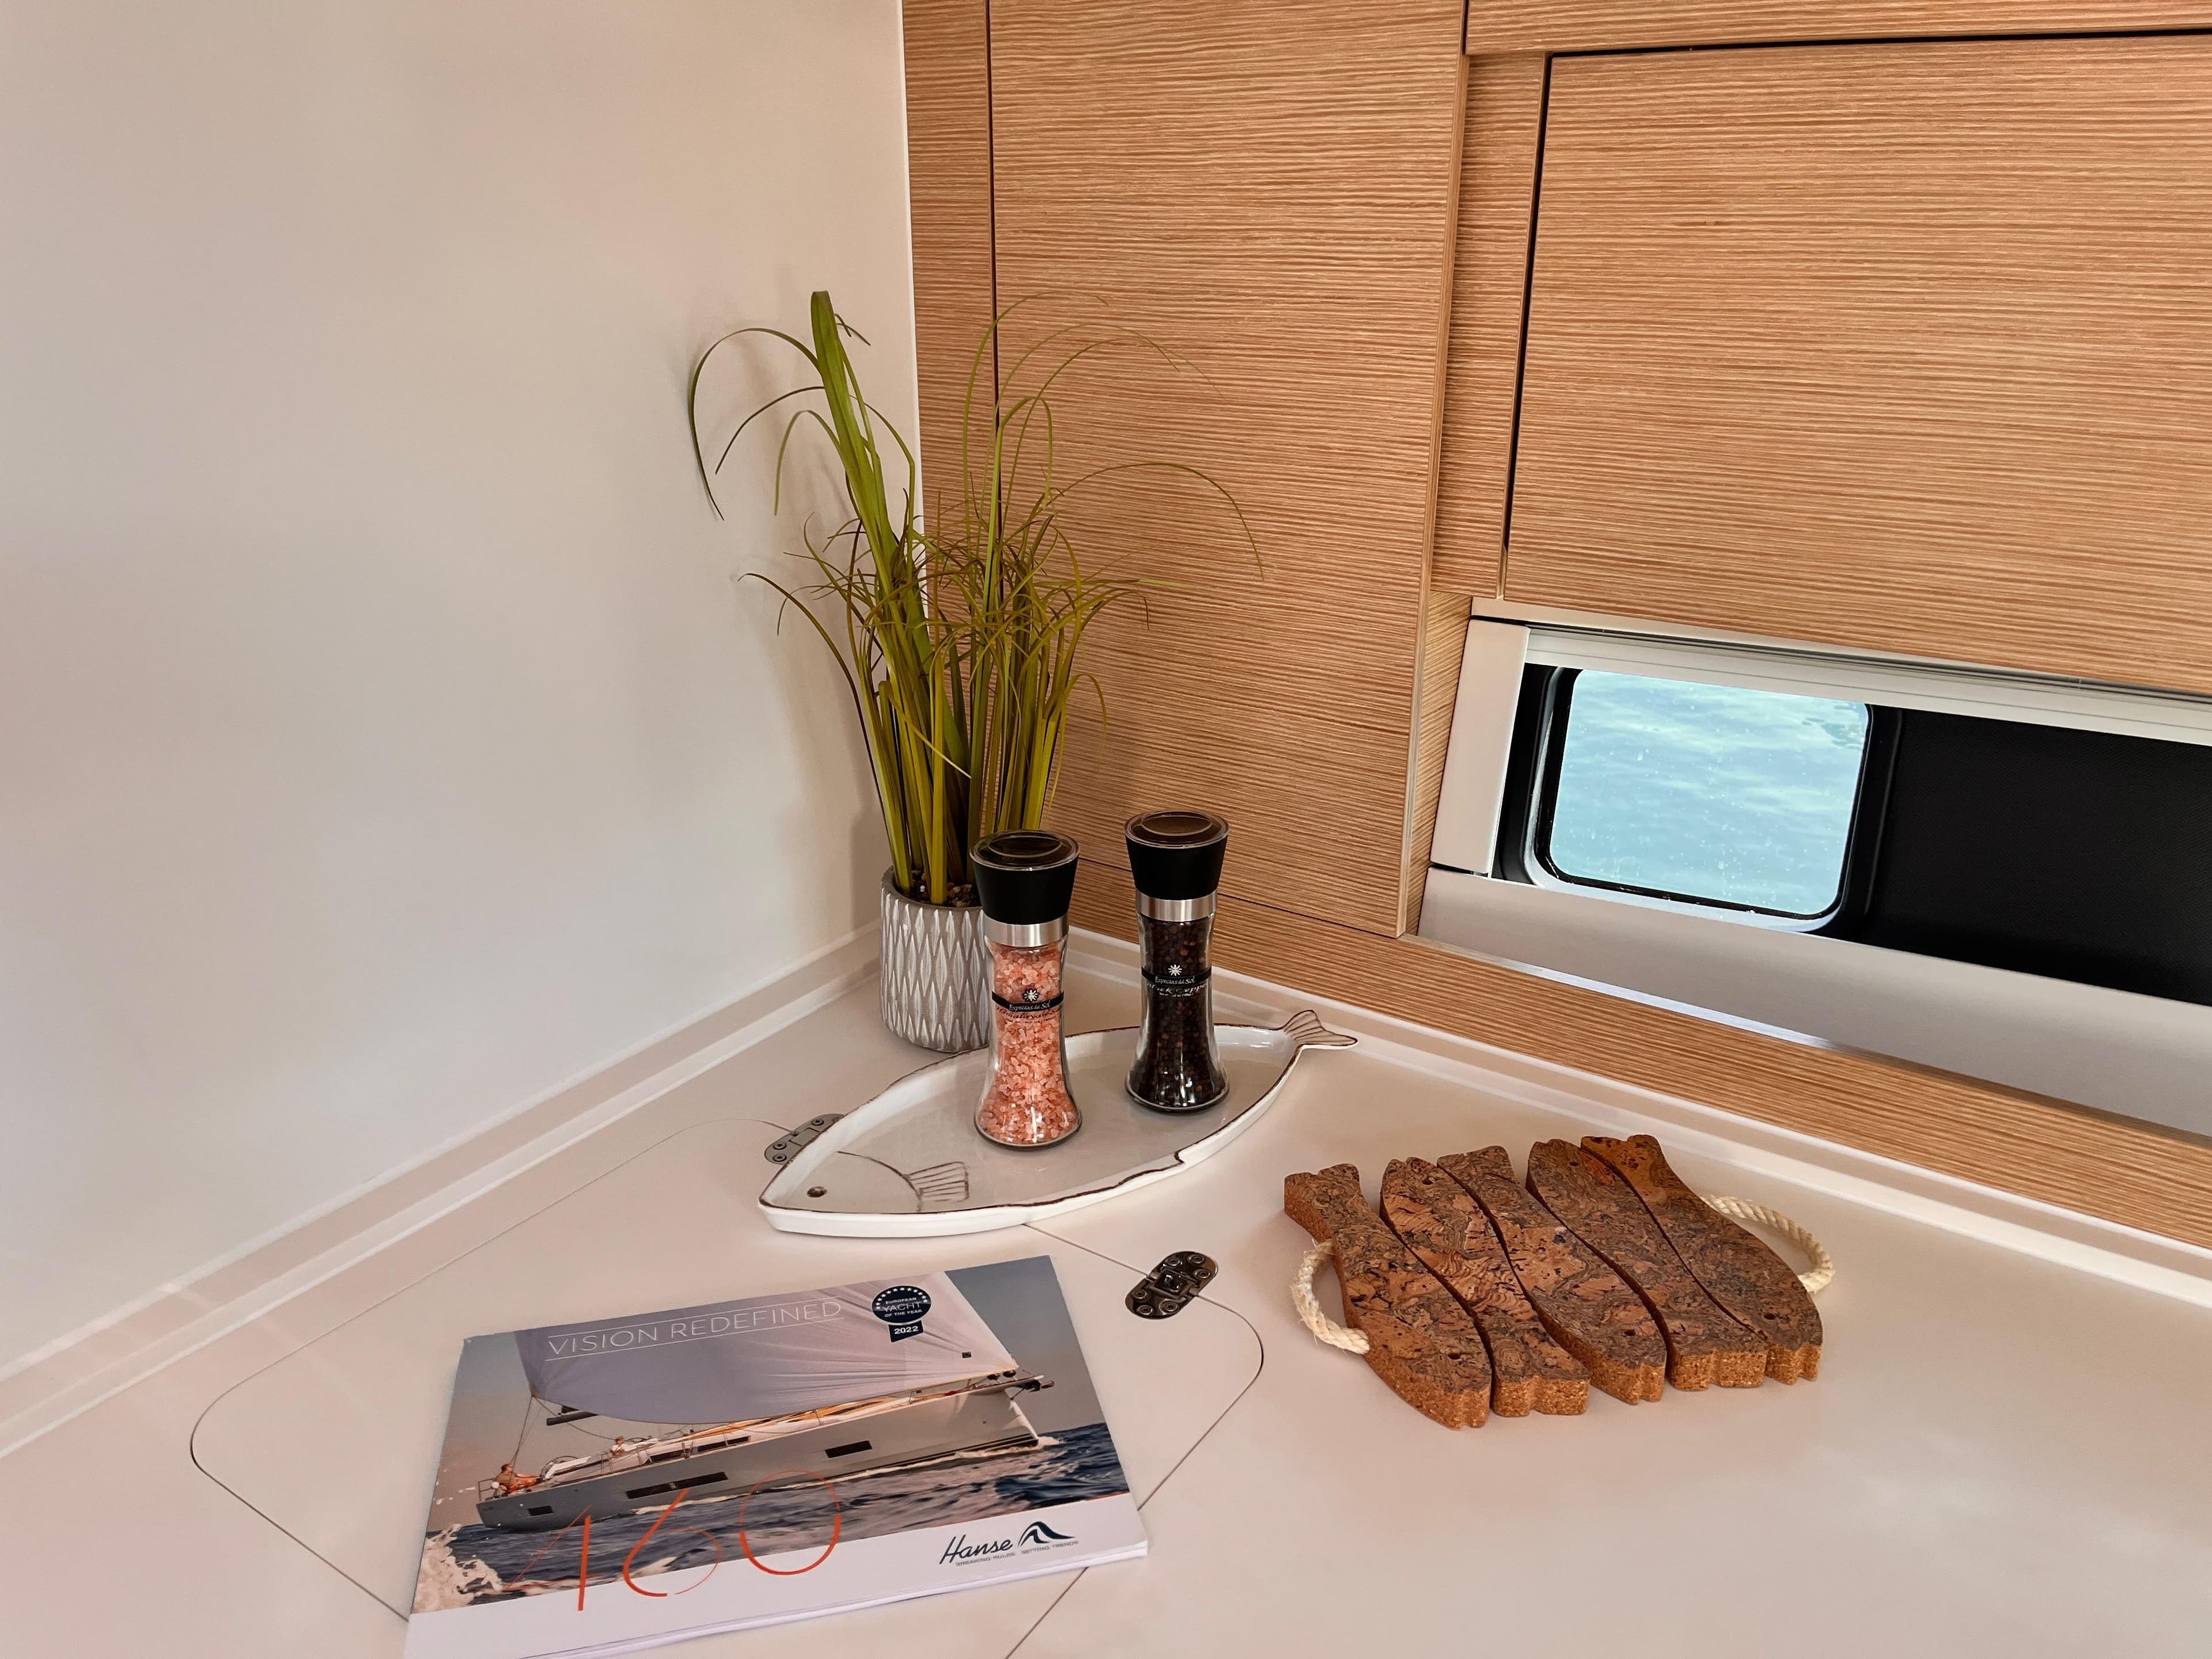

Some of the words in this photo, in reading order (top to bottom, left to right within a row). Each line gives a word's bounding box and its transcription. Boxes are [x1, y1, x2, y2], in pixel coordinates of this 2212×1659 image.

[1185, 975, 1196, 984] Sol
[1009, 1004, 1033, 1013] Especias
[1041, 999, 1051, 1009] Sol
[882, 1302, 921, 1312] YACHT
[548, 1326, 659, 1355] VISION
[671, 1300, 842, 1340] REDEFINED
[894, 1325, 919, 1335] 2022
[504, 1469, 842, 1612] 460
[939, 1534, 1013, 1565] Hanse
